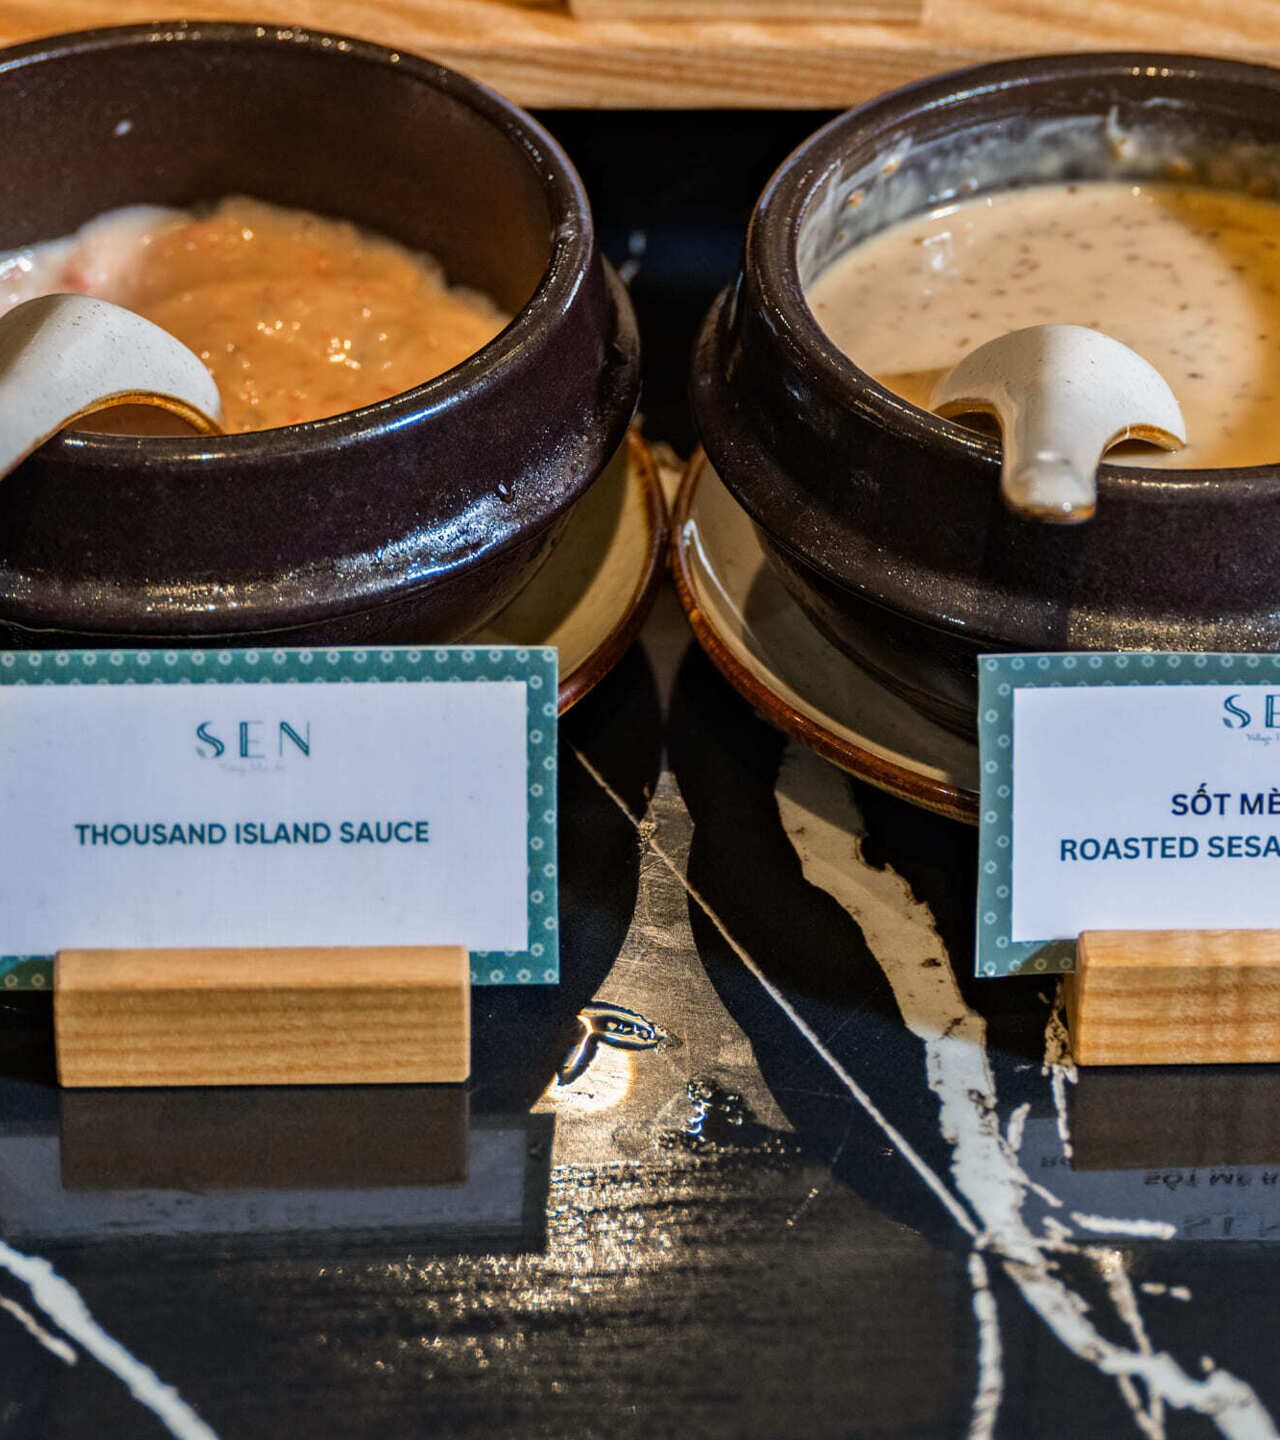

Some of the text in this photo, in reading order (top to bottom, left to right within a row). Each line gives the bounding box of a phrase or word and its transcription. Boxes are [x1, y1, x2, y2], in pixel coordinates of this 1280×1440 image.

[195, 720, 311, 758] SEN
[1171, 783, 1231, 816] SỐT
[75, 821, 429, 846] THOUSAND ISLAND SAUCE
[1060, 836, 1198, 861] ROASTED
